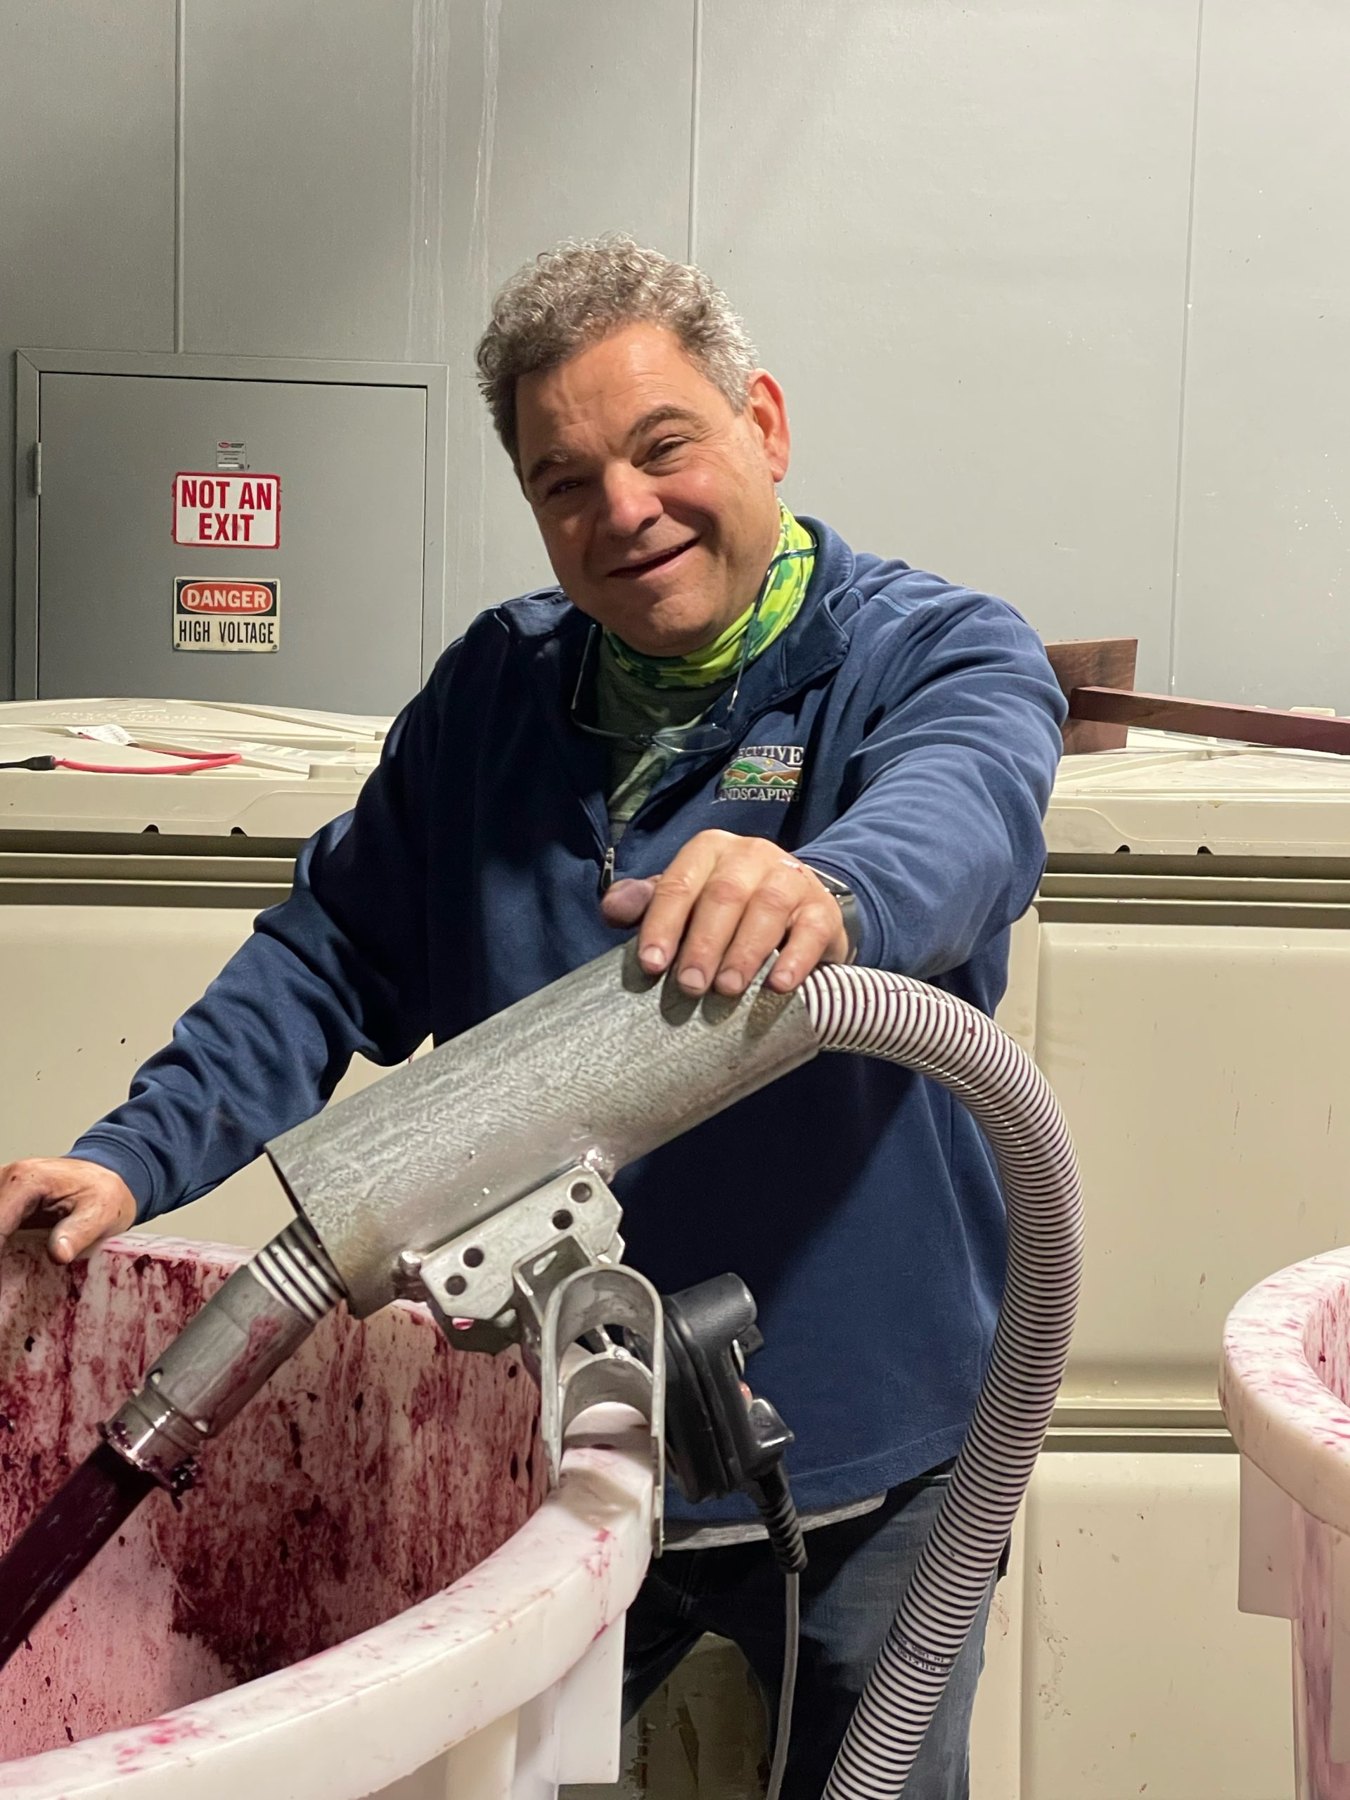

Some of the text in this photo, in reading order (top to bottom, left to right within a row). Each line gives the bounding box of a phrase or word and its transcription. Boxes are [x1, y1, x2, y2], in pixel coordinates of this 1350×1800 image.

[181, 480, 272, 511] NOT AN
[199, 513, 254, 542] EXIT
[186, 589, 267, 608] DANGER
[179, 620, 274, 644] HIGH VOLTAGE
[738, 745, 804, 766] ECUTIVE
[719, 787, 799, 802] NDSCAPING
